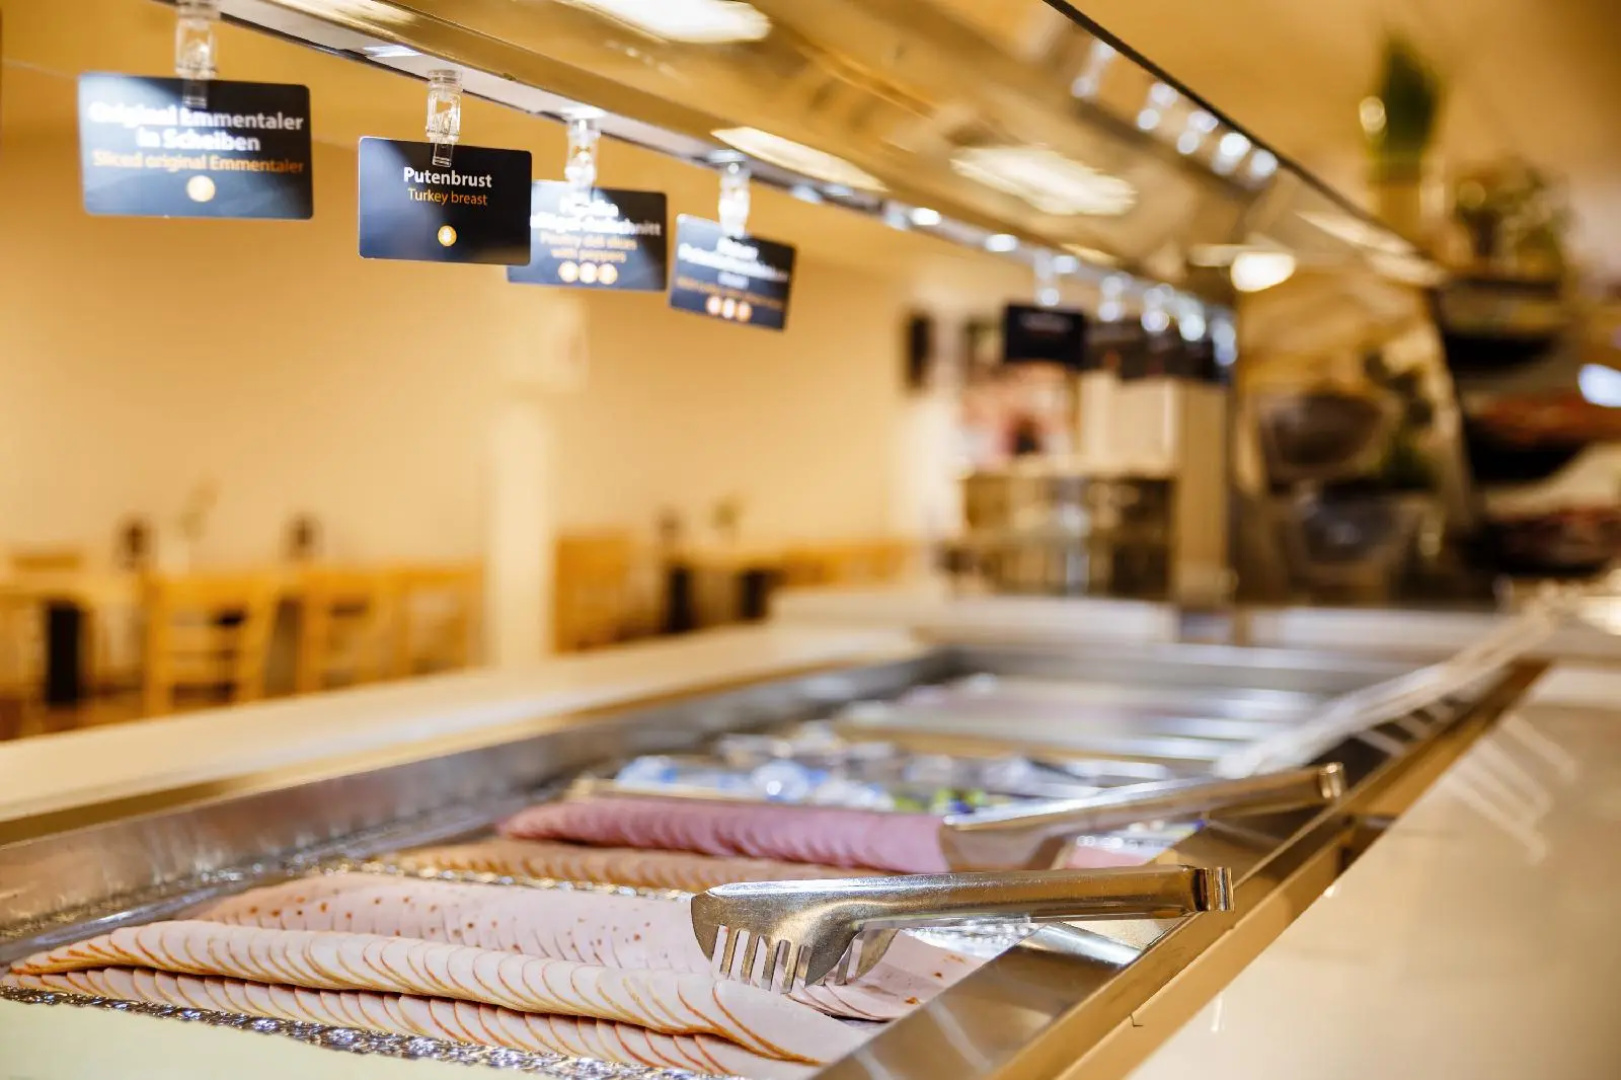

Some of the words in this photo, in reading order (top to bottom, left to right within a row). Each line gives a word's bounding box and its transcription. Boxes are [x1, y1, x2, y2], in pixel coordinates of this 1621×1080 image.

[180, 109, 304, 130] Emmentaler
[136, 128, 160, 148] in
[163, 128, 261, 151] Scheiben
[145, 153, 206, 173] original
[209, 155, 303, 174] Emmentaler
[403, 166, 493, 188] Putenbrust
[408, 188, 449, 206] Turkey
[451, 191, 488, 206] breast
